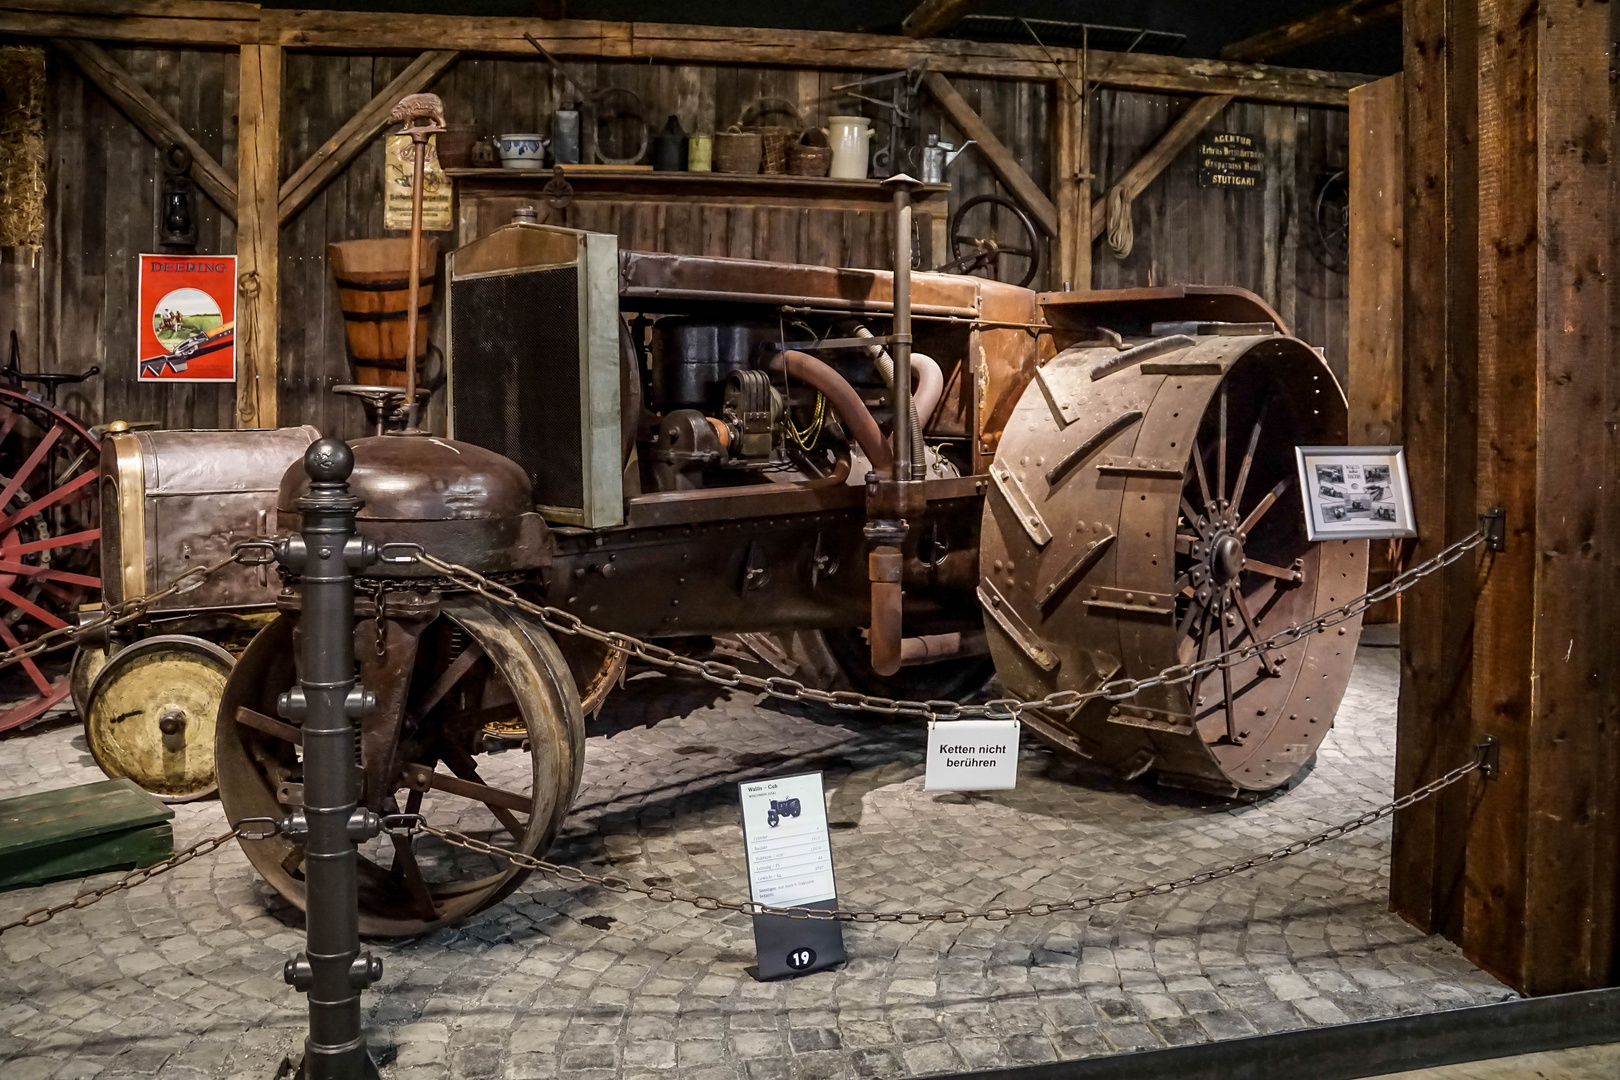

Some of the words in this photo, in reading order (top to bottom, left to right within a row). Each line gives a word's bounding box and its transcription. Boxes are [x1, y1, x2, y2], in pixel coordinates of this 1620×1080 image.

[1214, 135, 1252, 146] AGENTUR
[1212, 174, 1256, 186] STUTTGART
[151, 262, 227, 273] DEERING
[940, 744, 976, 754] Ketten
[978, 744, 1006, 754] nicht
[946, 758, 996, 767] berühren
[793, 951, 810, 966] 19
